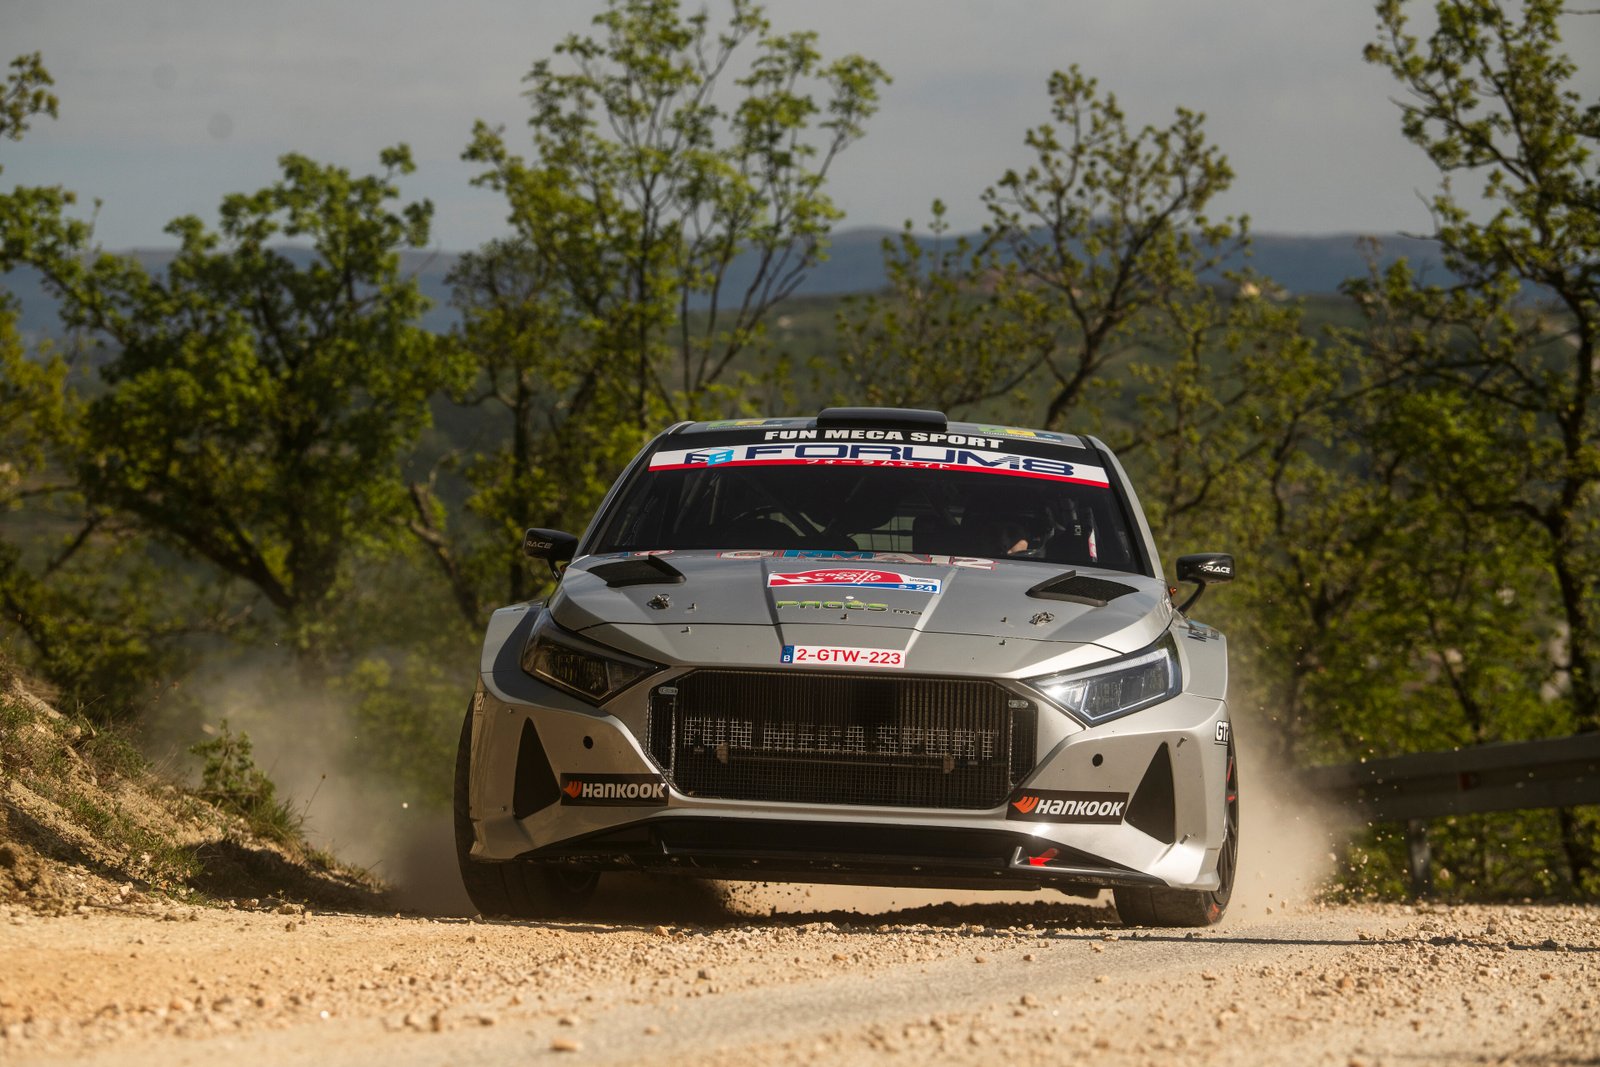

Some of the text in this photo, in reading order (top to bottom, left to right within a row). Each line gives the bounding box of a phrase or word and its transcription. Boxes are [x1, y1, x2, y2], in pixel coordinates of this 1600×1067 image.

[764, 430, 818, 440] FUN
[824, 429, 904, 441] MECA
[910, 431, 1004, 449] SPORT
[745, 444, 1075, 476] FORUM8
[796, 648, 901, 665] 2-GTW-223
